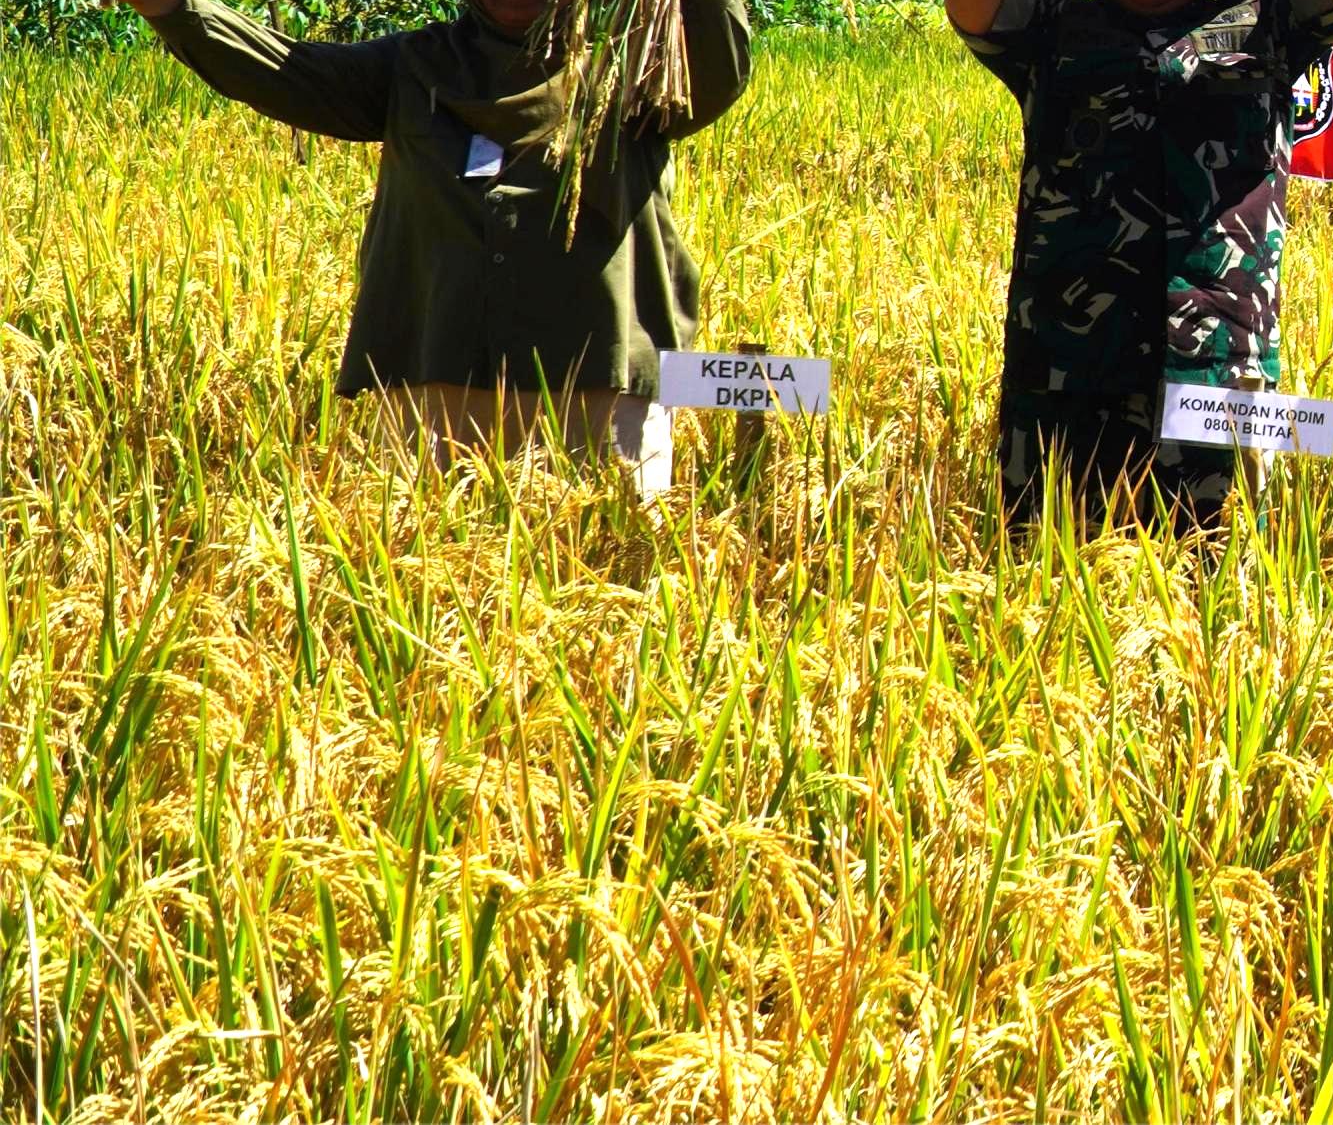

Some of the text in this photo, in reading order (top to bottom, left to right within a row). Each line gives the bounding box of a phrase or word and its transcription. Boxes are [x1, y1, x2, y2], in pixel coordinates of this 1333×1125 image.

[701, 359, 796, 382] KEPALA
[1179, 396, 1325, 425] KOMANDAN KODIM
